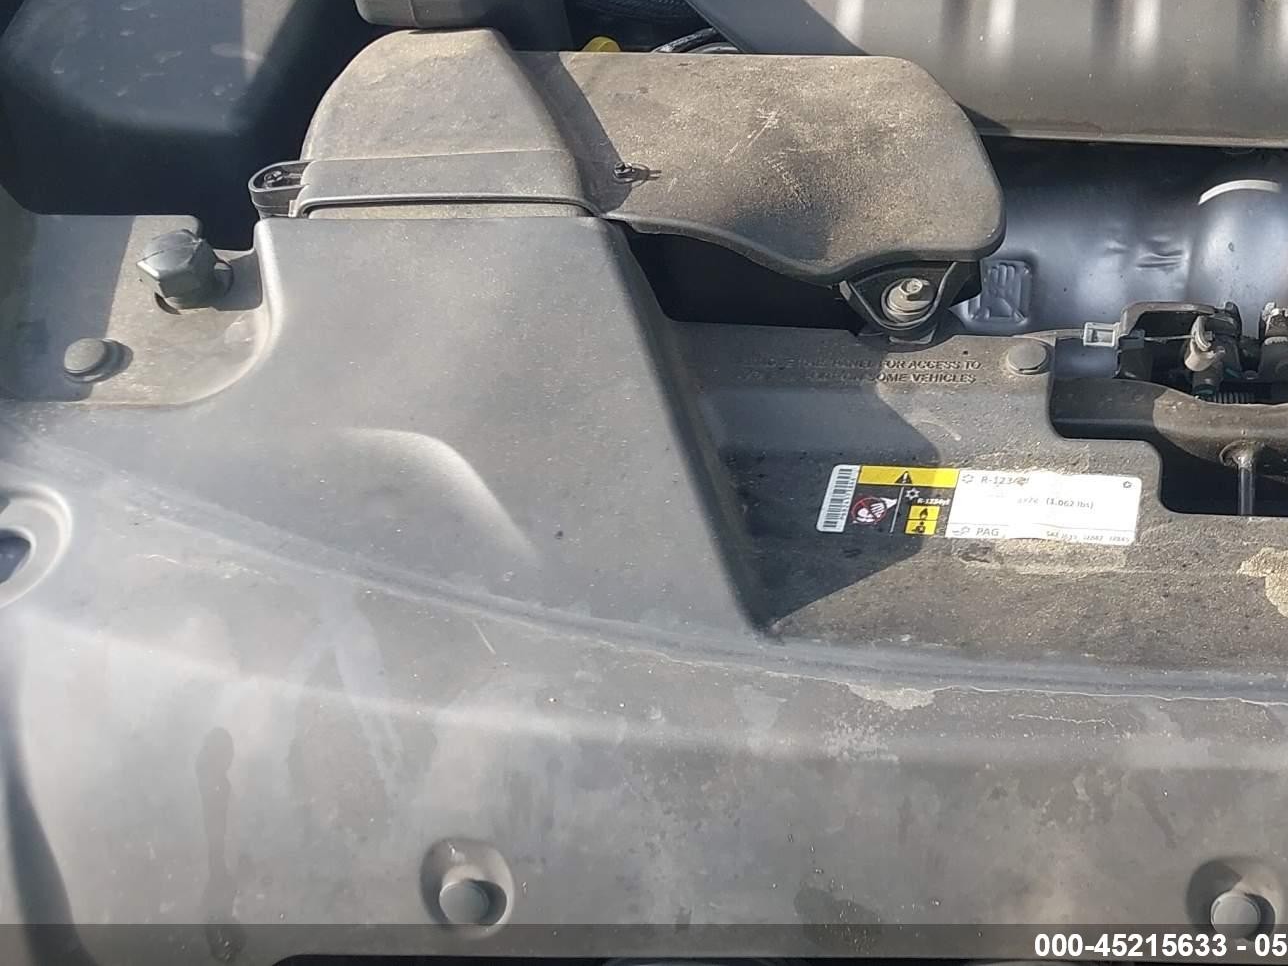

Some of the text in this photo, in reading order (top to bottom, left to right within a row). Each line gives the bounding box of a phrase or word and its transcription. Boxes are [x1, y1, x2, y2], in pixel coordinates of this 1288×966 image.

[880, 360, 905, 369] FOR
[908, 360, 961, 370] ACCESS
[963, 360, 982, 370] TO
[911, 372, 977, 384] VEHICLES
[975, 527, 1000, 537] PAG
